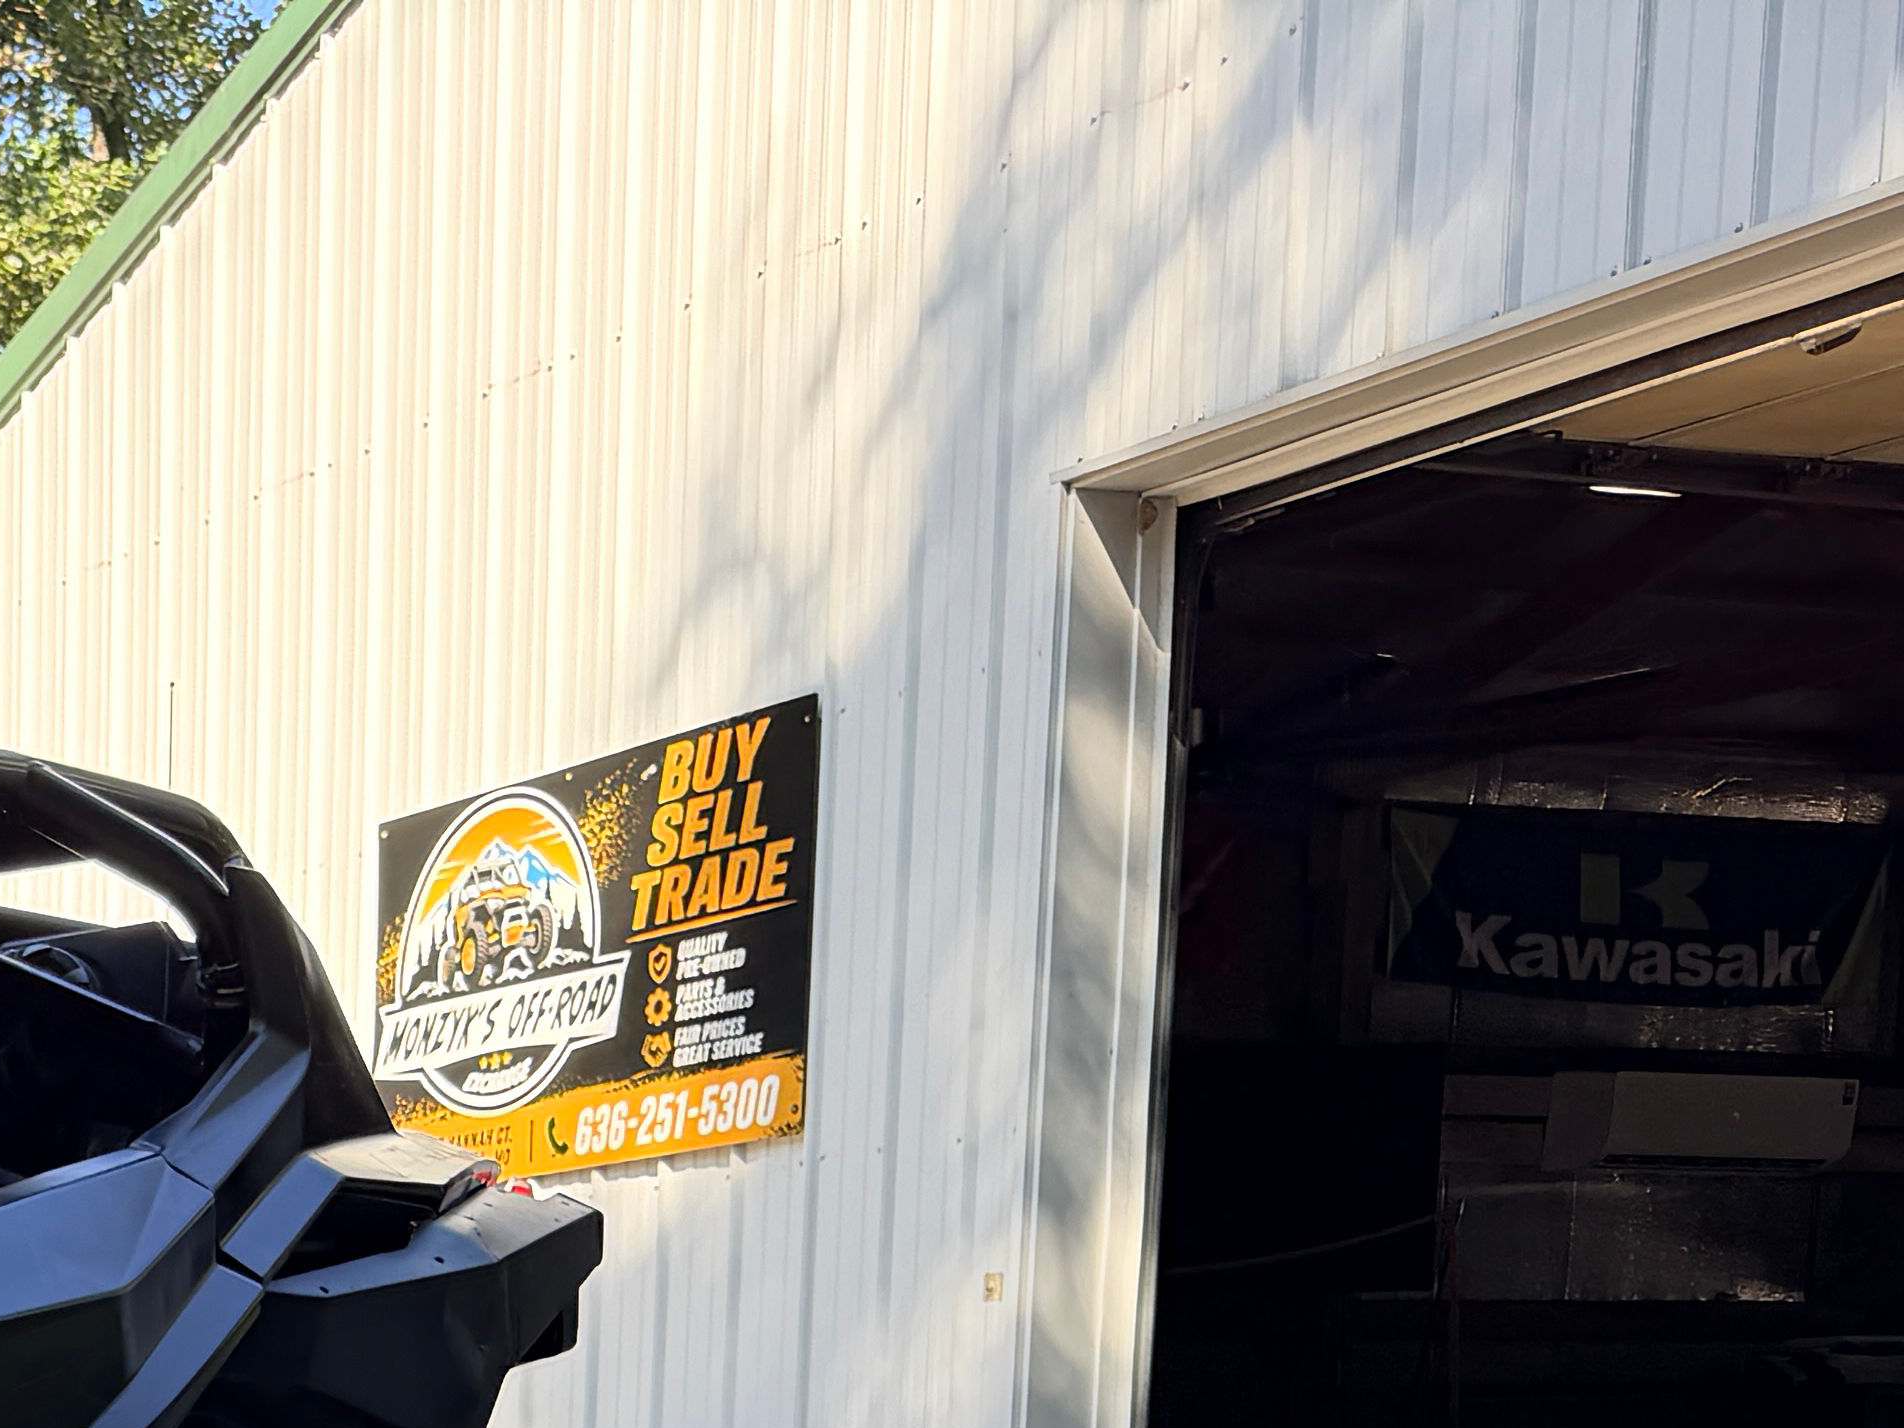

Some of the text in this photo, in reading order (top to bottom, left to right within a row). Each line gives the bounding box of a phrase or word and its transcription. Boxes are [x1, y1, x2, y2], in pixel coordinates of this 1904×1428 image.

[658, 716, 771, 804] BUY
[647, 781, 768, 867] SELL
[631, 837, 795, 931] TRADE
[677, 931, 728, 961] QUALITY
[1455, 911, 1823, 989] Kawasaki
[507, 973, 618, 1040] OFF-ROAD
[674, 988, 755, 1022] ACCESSORIES
[675, 978, 714, 1004] PARTS
[673, 1016, 746, 1047] FAIR PRICES
[673, 1032, 765, 1068] GREAT SERVICE
[574, 1074, 781, 1156] 636-251-5300
